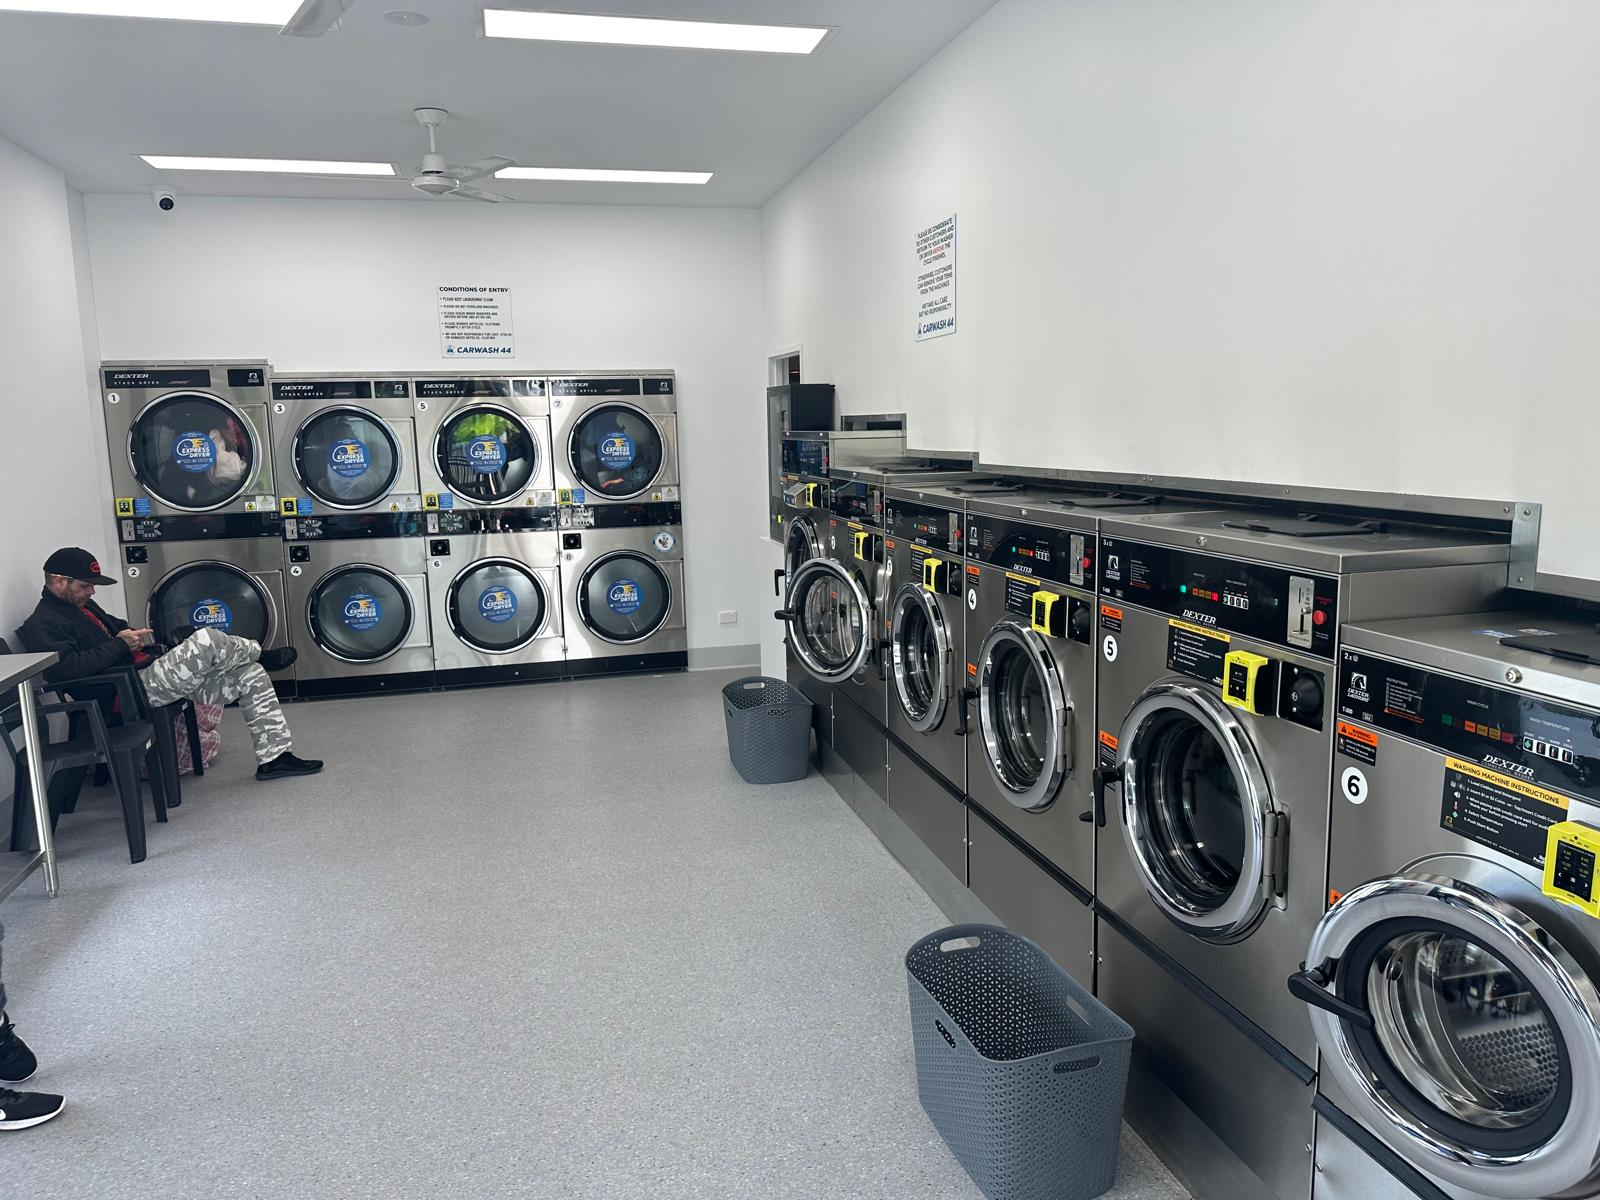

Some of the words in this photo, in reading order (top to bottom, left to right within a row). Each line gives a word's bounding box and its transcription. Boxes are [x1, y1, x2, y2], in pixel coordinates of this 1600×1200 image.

[923, 319, 946, 334] CARWASH
[946, 316, 954, 327] 44
[1013, 564, 1032, 574] DEXTER
[970, 592, 975, 606] 4
[1182, 610, 1216, 624] DEXTER
[1107, 641, 1113, 656] 5
[1348, 688, 1369, 698] DEXTER
[1542, 719, 1570, 732] TEMPERATURE
[1481, 760, 1512, 774] COMMERCIAL
[1483, 754, 1534, 776] DEXTER
[1348, 774, 1360, 796] 6
[1453, 762, 1480, 776] WASHING
[1482, 772, 1510, 786] MACHINE
[1511, 783, 1559, 804] INSTRUCTIONS
[1480, 783, 1494, 791] Clothes
[1502, 792, 1521, 801] Detergent
[1480, 815, 1503, 827] Temperature
[1501, 815, 1517, 824] pressing
[1486, 826, 1499, 834] Button
